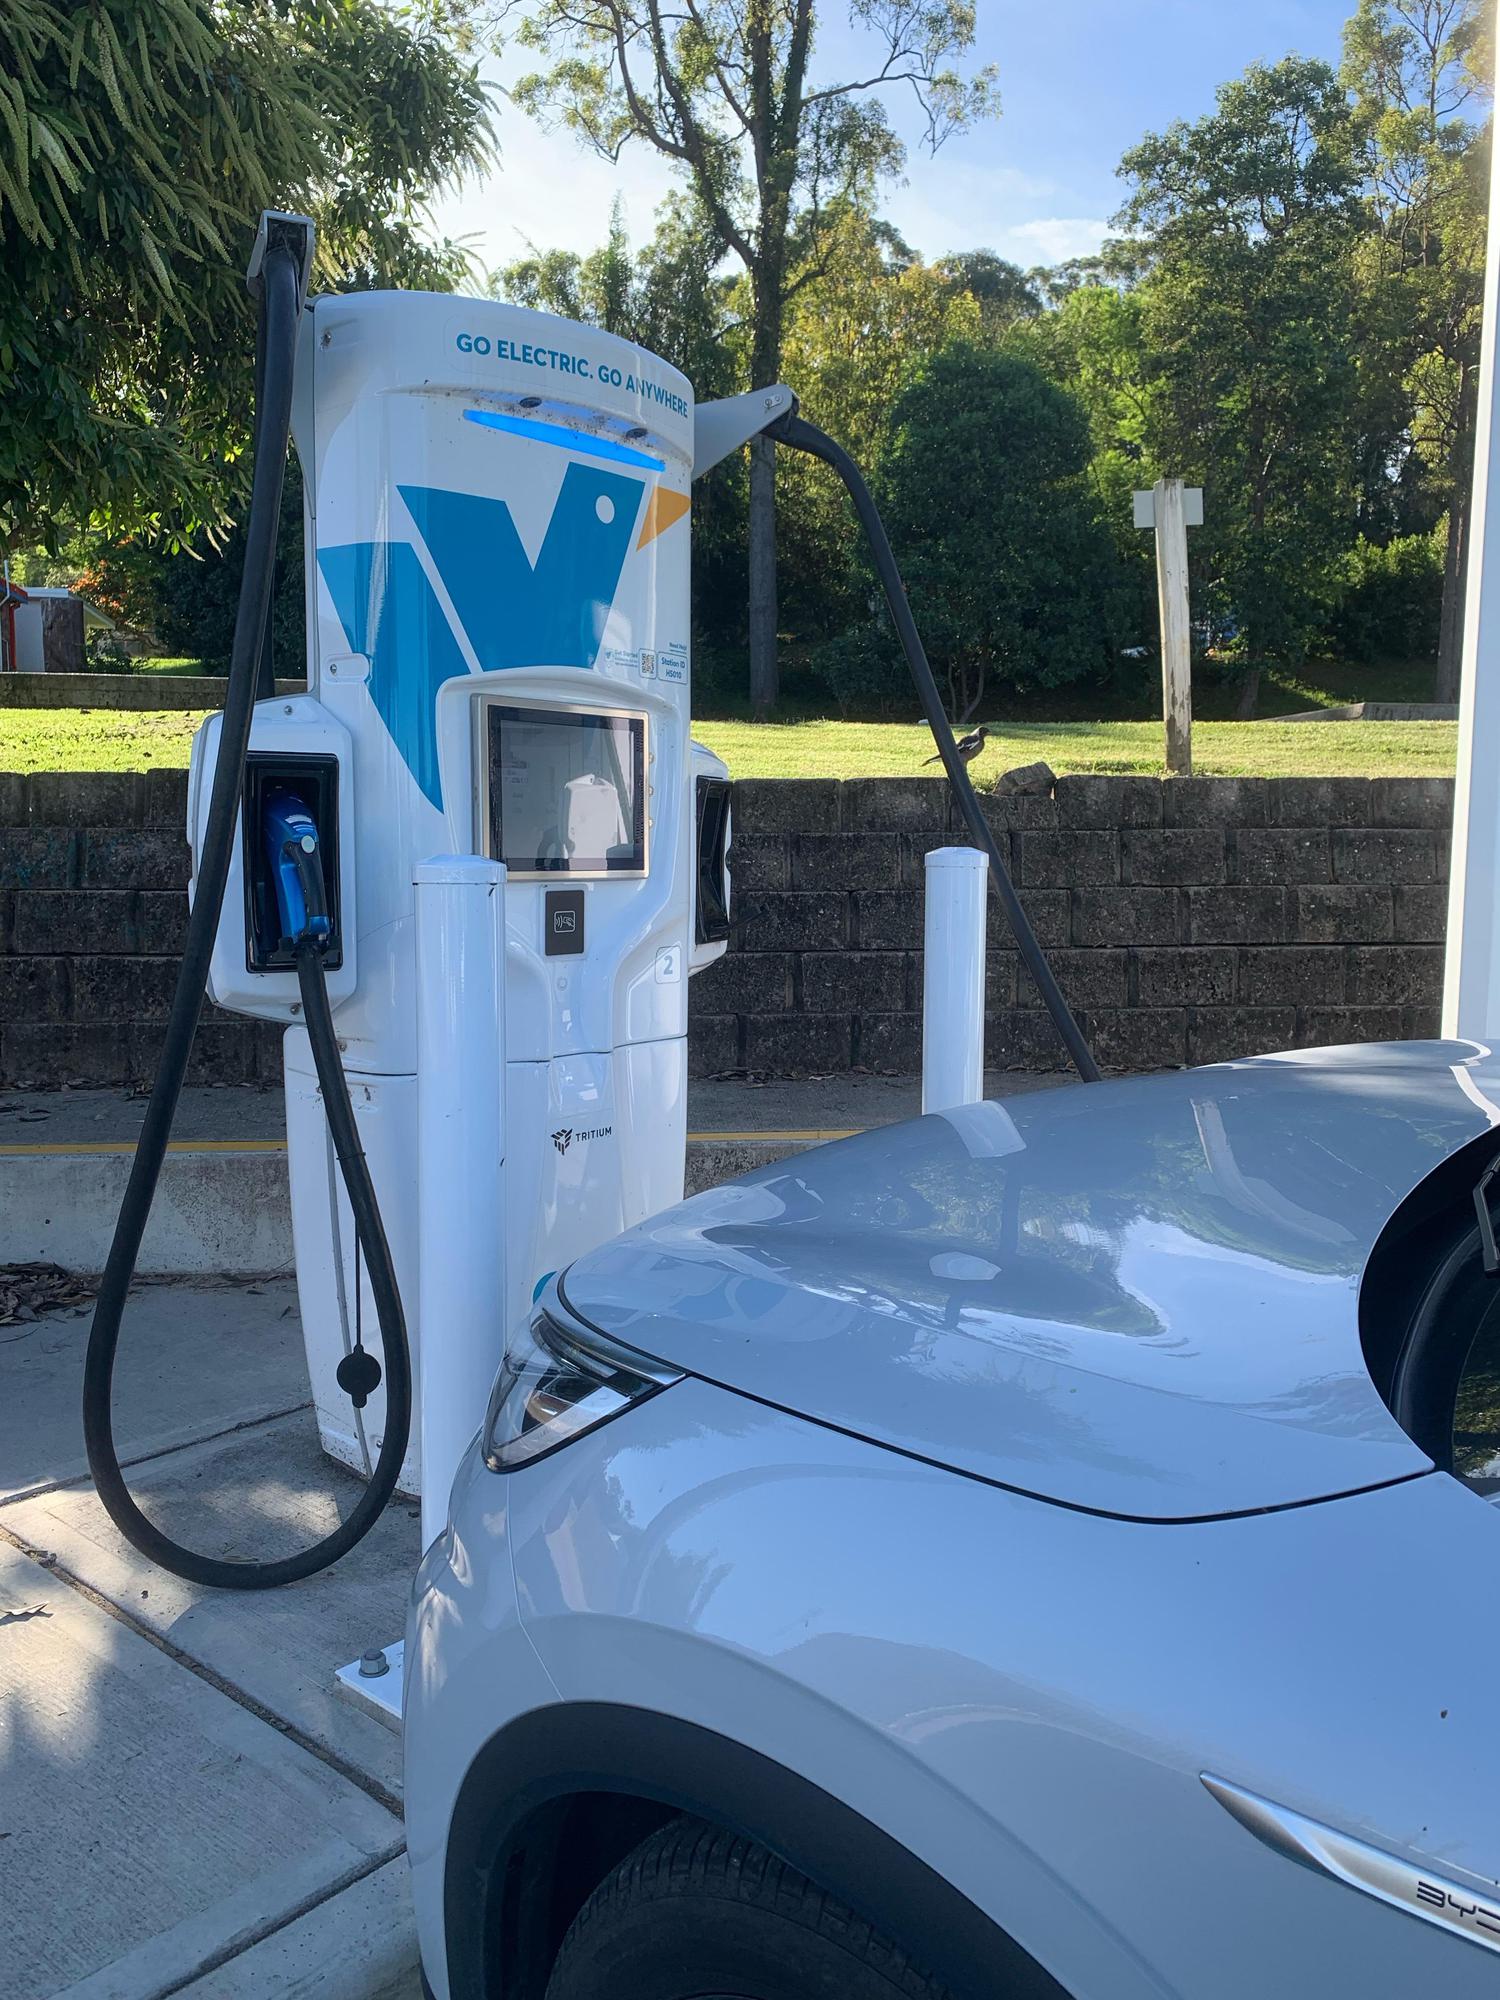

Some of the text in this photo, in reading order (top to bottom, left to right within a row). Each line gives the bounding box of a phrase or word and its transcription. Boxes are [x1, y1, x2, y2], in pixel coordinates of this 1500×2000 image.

[456, 333, 688, 418] GO ELECTRIC. GO ANYWHERE
[661, 656, 686, 669] Station ID
[663, 955, 673, 975] 2
[576, 1126, 612, 1142] TRITIUM
